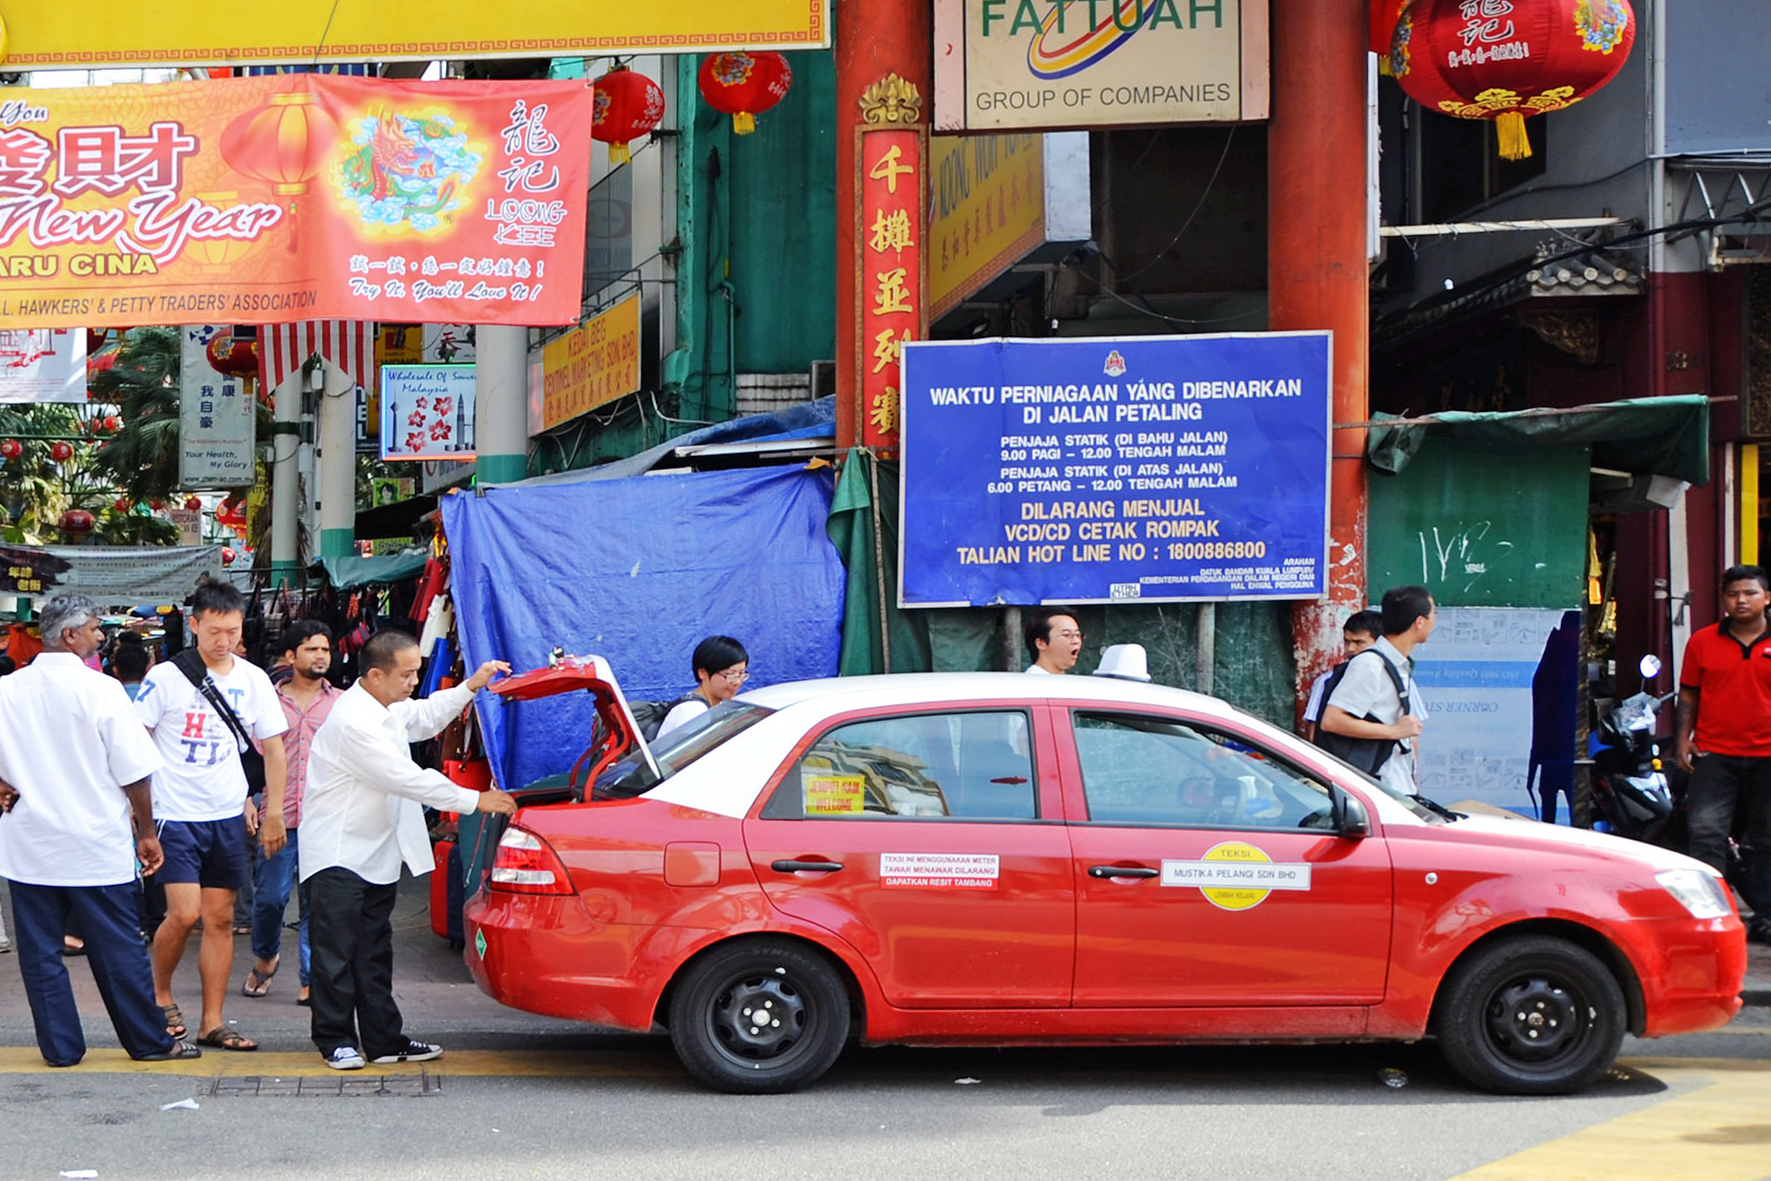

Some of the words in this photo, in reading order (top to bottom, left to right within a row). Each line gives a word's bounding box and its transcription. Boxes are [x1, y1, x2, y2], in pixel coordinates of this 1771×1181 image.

[976, 86, 1058, 113] GROUP
[1063, 85, 1093, 109] OF
[1100, 82, 1231, 107] COMPANIES
[498, 98, 560, 193] 龍記
[485, 198, 567, 224] LOONG
[114, 189, 283, 265] Year
[493, 223, 556, 247] KEE
[68, 253, 159, 277] CINA
[348, 278, 381, 298] Try
[413, 279, 463, 302] You'll
[464, 282, 507, 300] Love
[109, 296, 157, 314] PETTY
[232, 291, 317, 311] ASSOCIATION
[388, 371, 434, 381] Wholesale
[402, 383, 449, 396] Malaysia
[930, 386, 995, 405] WAKTU
[1001, 384, 1118, 404] PERNIAGAAN
[1127, 381, 1176, 401] YANG
[1183, 379, 1302, 399] DIBENARKAN
[1023, 406, 1042, 424] DI
[1049, 405, 1109, 423] JALAN
[1116, 402, 1203, 422] PETALING
[1001, 435, 1059, 448] PENJAJA
[1065, 434, 1109, 447] STATIK
[1114, 433, 1133, 447] (DI
[1138, 432, 1175, 445] BAHU
[1179, 431, 1229, 446] JALAN)
[1000, 449, 1027, 461] 9.00
[1031, 448, 1061, 460] PAGI
[1081, 447, 1112, 460] 12.00
[1117, 446, 1172, 459] TENGAH
[1177, 444, 1226, 457] MALAM
[1000, 466, 1059, 479] PENJAJA
[1064, 465, 1108, 478] STATIK
[1113, 464, 1132, 478] (DI
[1137, 464, 1170, 476] ATAS
[1175, 462, 1224, 477] JALAN)
[987, 481, 1014, 493] 6.00
[1018, 480, 1072, 492] PETANG
[1091, 479, 1123, 491] 12.00
[1128, 478, 1184, 490] TENGAH
[1188, 476, 1238, 489] MALAM
[1021, 501, 1115, 520] DILARANG
[1122, 498, 1205, 517] MENJUAL
[1004, 523, 1072, 542] VCD/CD
[1079, 522, 1138, 540] CETAK
[1146, 519, 1220, 539] ROMPAK
[957, 546, 1020, 565] TALIAN
[1028, 545, 1065, 563] HOT
[1072, 544, 1111, 562] LINE
[1119, 543, 1146, 561] NO
[1166, 541, 1266, 560] 1800886800
[1283, 557, 1316, 566] ARAHAN
[1200, 568, 1223, 577] DATUK
[1224, 567, 1254, 576] BANDAR
[1256, 566, 1281, 575] KUALA
[1299, 573, 1315, 581] DAN
[1231, 582, 1246, 590] HAL
[1275, 580, 1314, 589] PENGGUNA
[816, 798, 852, 811] WELCOME
[917, 856, 971, 864] MENGGUNAKAN
[973, 857, 996, 865] METER
[1221, 850, 1251, 858] TEKSI
[884, 866, 911, 874] TAWAR
[913, 866, 953, 874] MENAWAR
[955, 867, 996, 875] DILARANG
[1174, 869, 1213, 877] MUSTIKA
[1216, 869, 1254, 878] PELANGI
[1257, 871, 1275, 879] SDN
[1278, 871, 1296, 880] BHD
[886, 878, 928, 886] DAPATKAN
[929, 879, 952, 887] RESIT
[954, 879, 993, 887] TAMBANG
